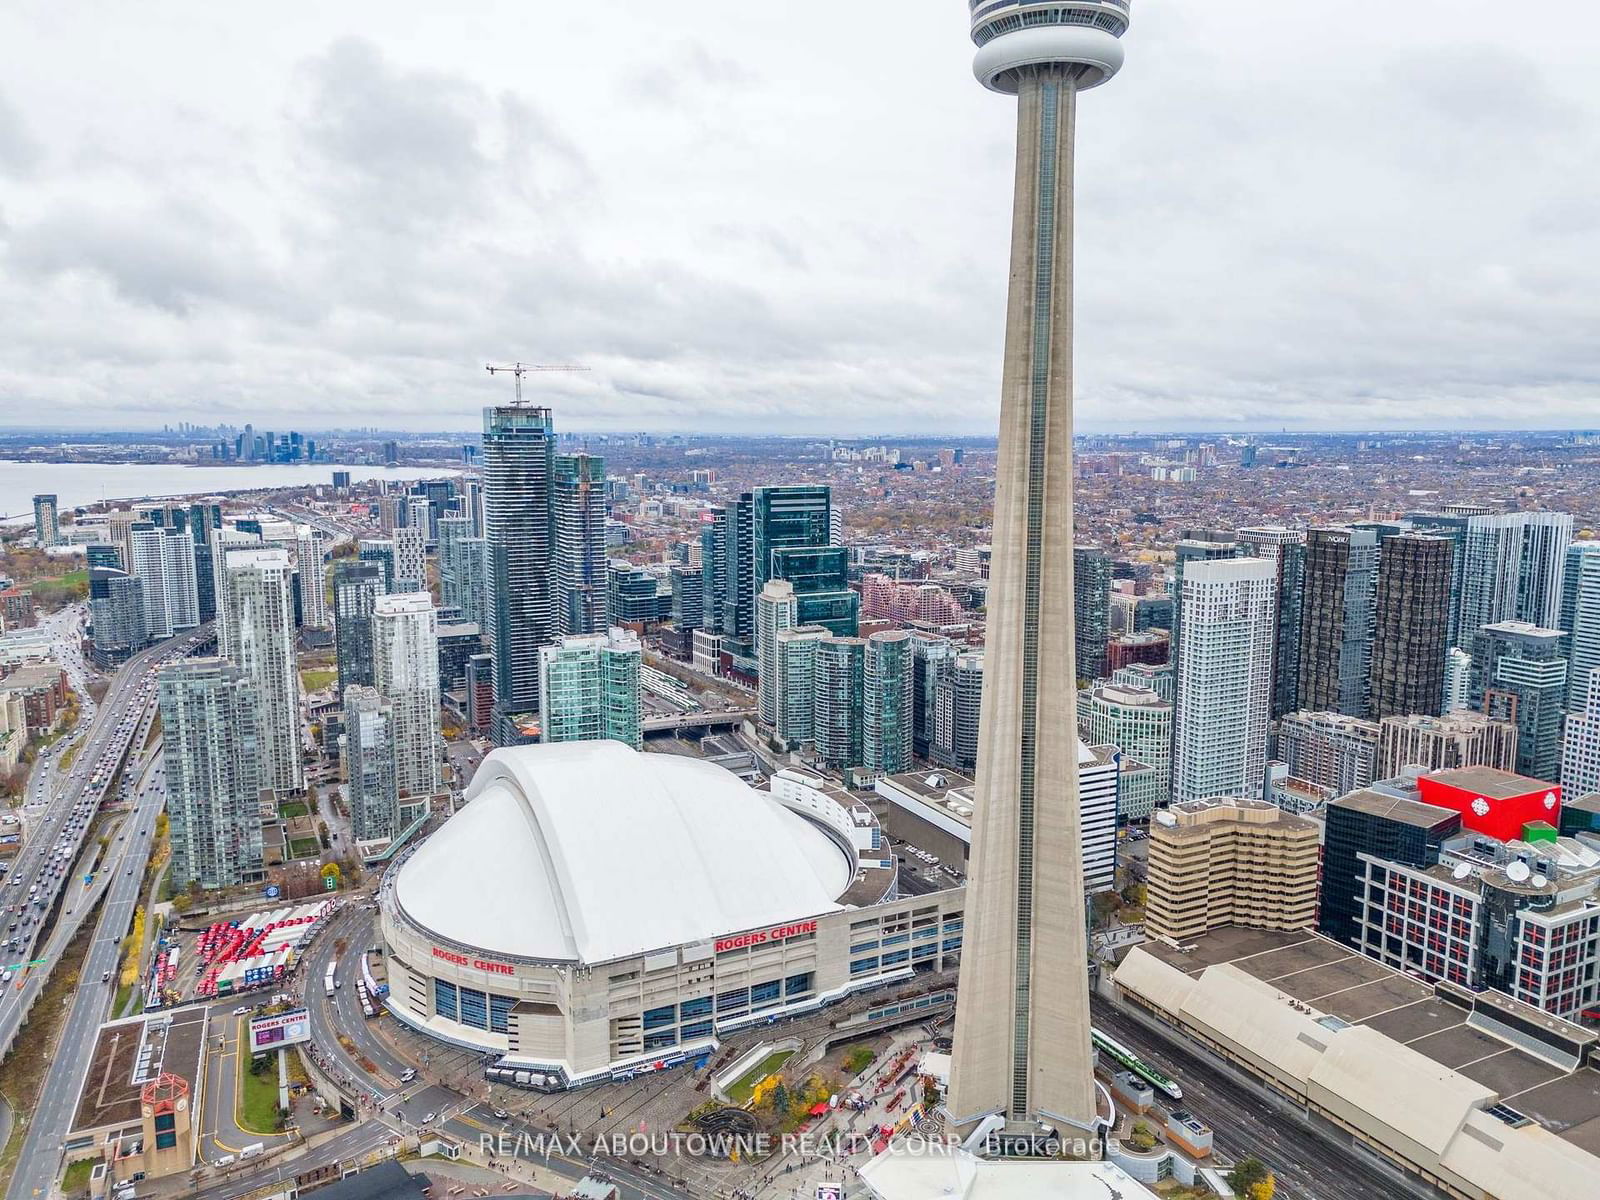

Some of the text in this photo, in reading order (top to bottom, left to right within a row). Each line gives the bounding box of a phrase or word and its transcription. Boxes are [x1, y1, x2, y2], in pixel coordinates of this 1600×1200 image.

[715, 920, 817, 952] ROGERS CENTRE
[432, 947, 515, 975] ROGERS CENTRE
[251, 1014, 307, 1030] ROGERS CENTRE
